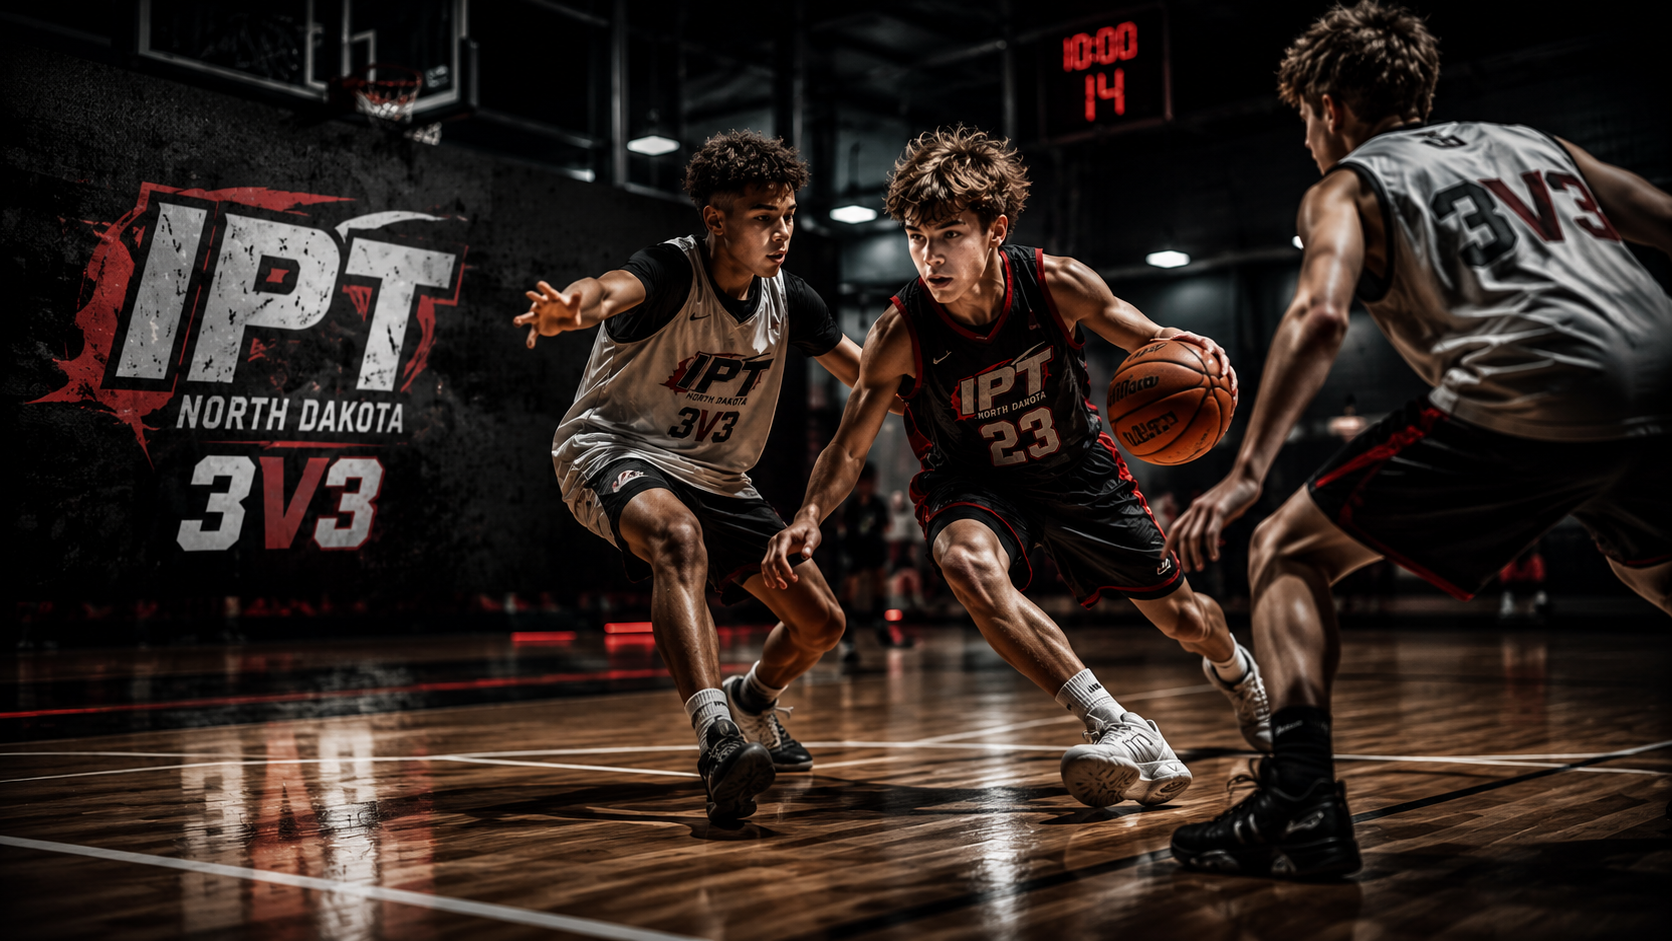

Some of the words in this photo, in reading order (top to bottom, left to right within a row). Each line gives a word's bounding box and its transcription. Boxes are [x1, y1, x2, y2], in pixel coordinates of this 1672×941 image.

[1063, 21, 1138, 73] 10:00
[1085, 67, 1125, 122] 14
[1430, 169, 1622, 267] 3V3
[116, 202, 457, 391] IPT
[676, 352, 775, 397] IPT
[960, 344, 1053, 416] IPT
[176, 394, 290, 431] NORTH
[299, 399, 403, 433] DAKOTA
[667, 406, 740, 443] 3V3
[978, 404, 1009, 420] NORTH
[979, 406, 1061, 467] 23
[176, 455, 386, 551] 3V3
